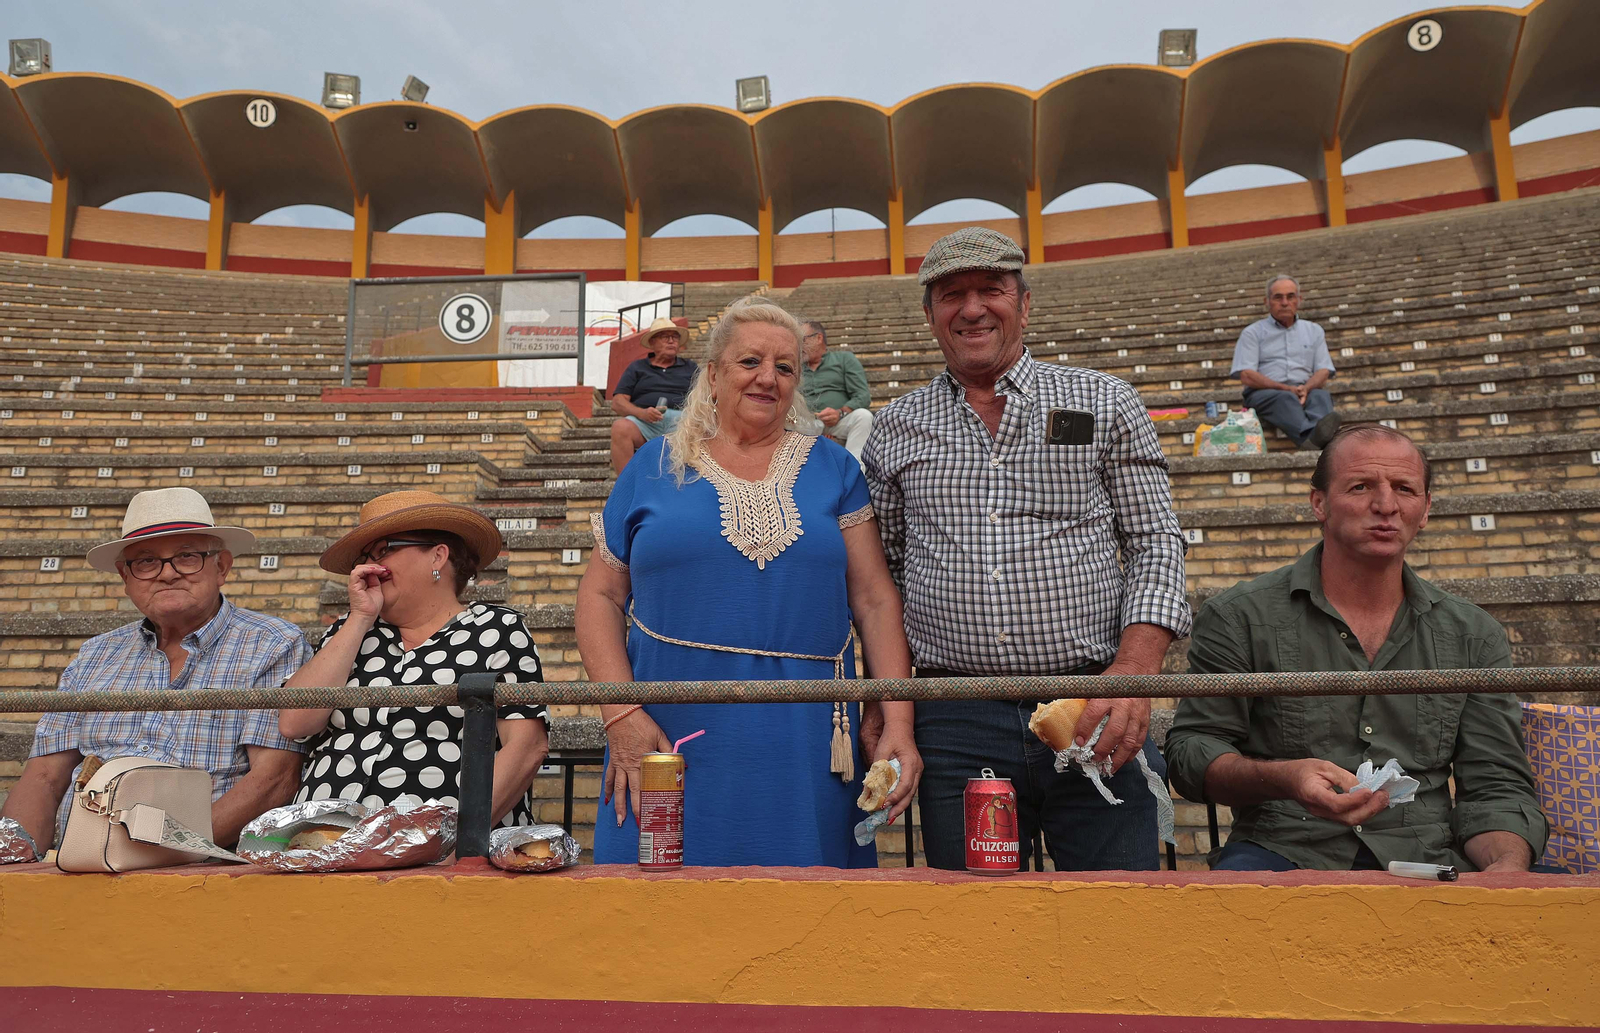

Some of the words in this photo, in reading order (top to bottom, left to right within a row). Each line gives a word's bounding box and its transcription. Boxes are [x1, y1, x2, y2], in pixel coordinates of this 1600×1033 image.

[1418, 25, 1432, 46] 8
[250, 104, 268, 122] 10
[456, 304, 475, 334] 8
[1582, 374, 1592, 383] 12
[1484, 384, 1494, 392] 11
[1390, 391, 1400, 399] 10
[1495, 414, 1505, 423] 10
[1474, 460, 1480, 470] 9
[1239, 474, 1244, 482] 7
[498, 521, 521, 529] FILA
[1480, 517, 1487, 528] 8
[1190, 530, 1195, 540] 6
[44, 558, 56, 568] 28
[264, 557, 274, 566] 30
